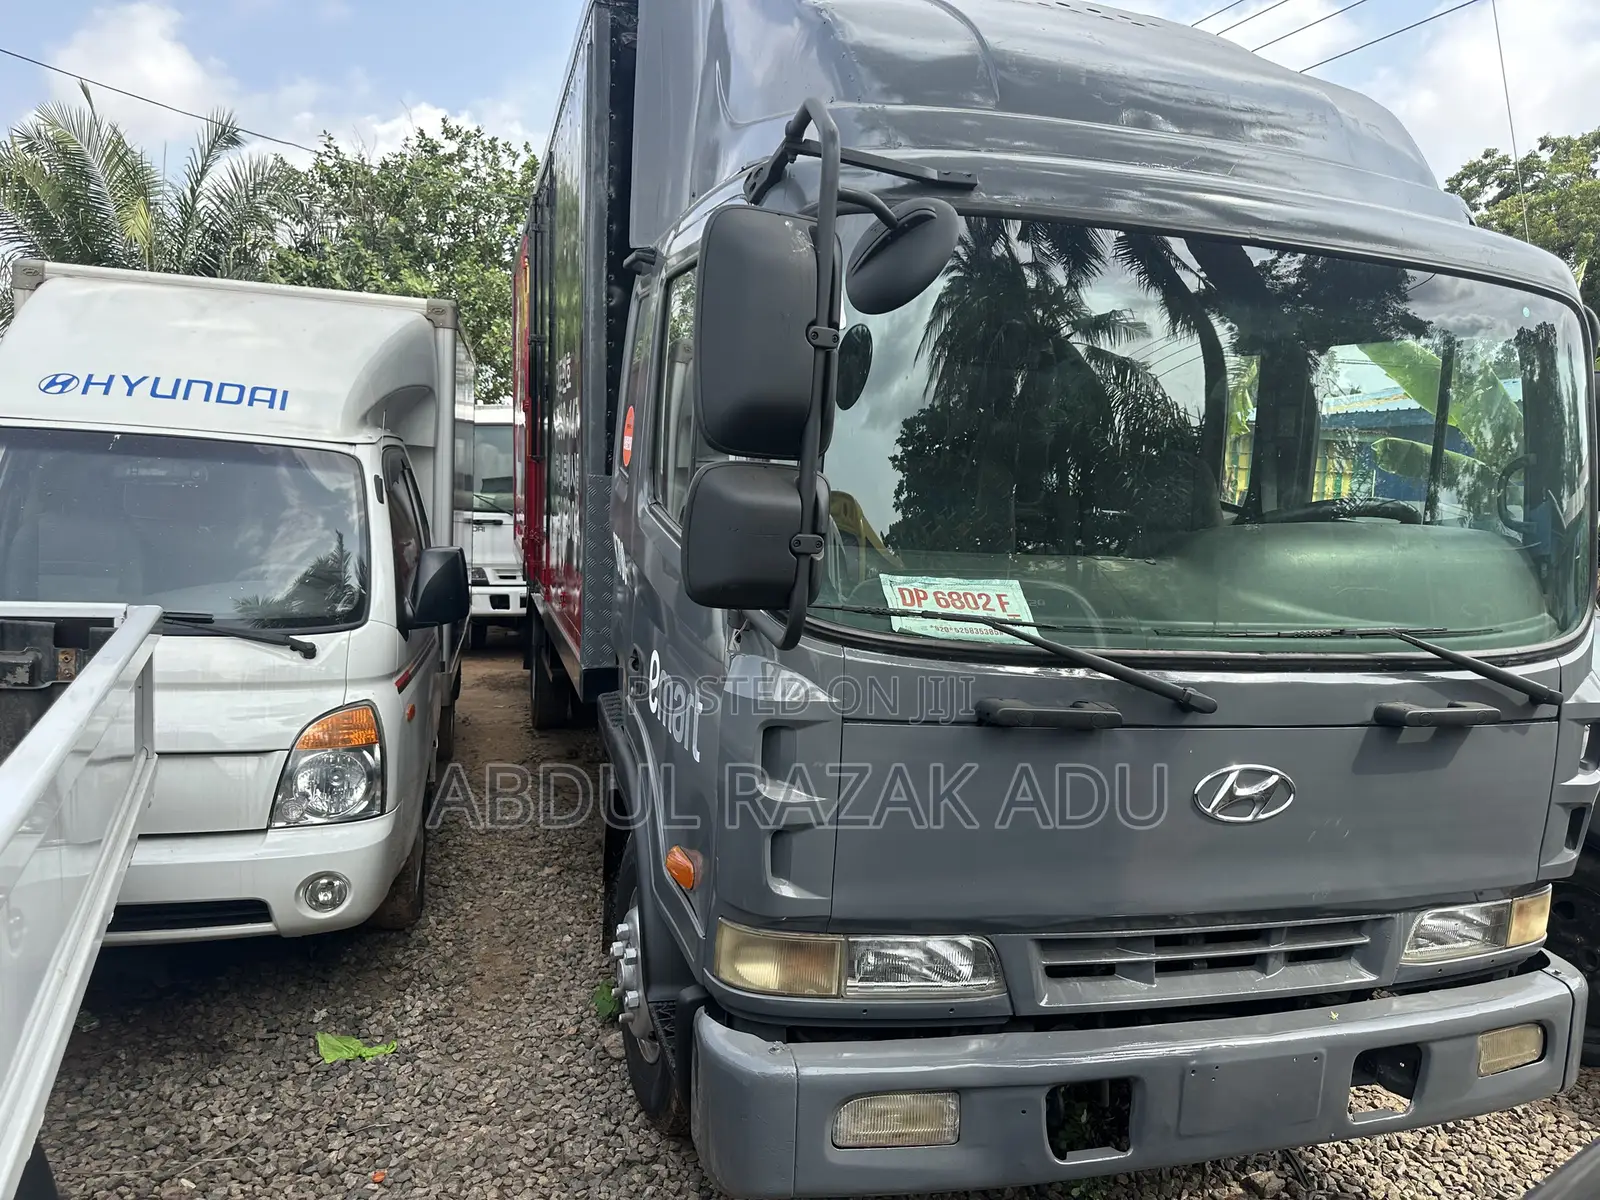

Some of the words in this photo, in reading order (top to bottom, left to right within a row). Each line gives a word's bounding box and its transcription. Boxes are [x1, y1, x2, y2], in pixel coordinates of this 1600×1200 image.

[81, 373, 289, 411] HYUNDAI
[898, 587, 928, 608] DP
[932, 590, 996, 612] 6802
[996, 593, 1010, 613] F
[649, 649, 703, 763] emart
